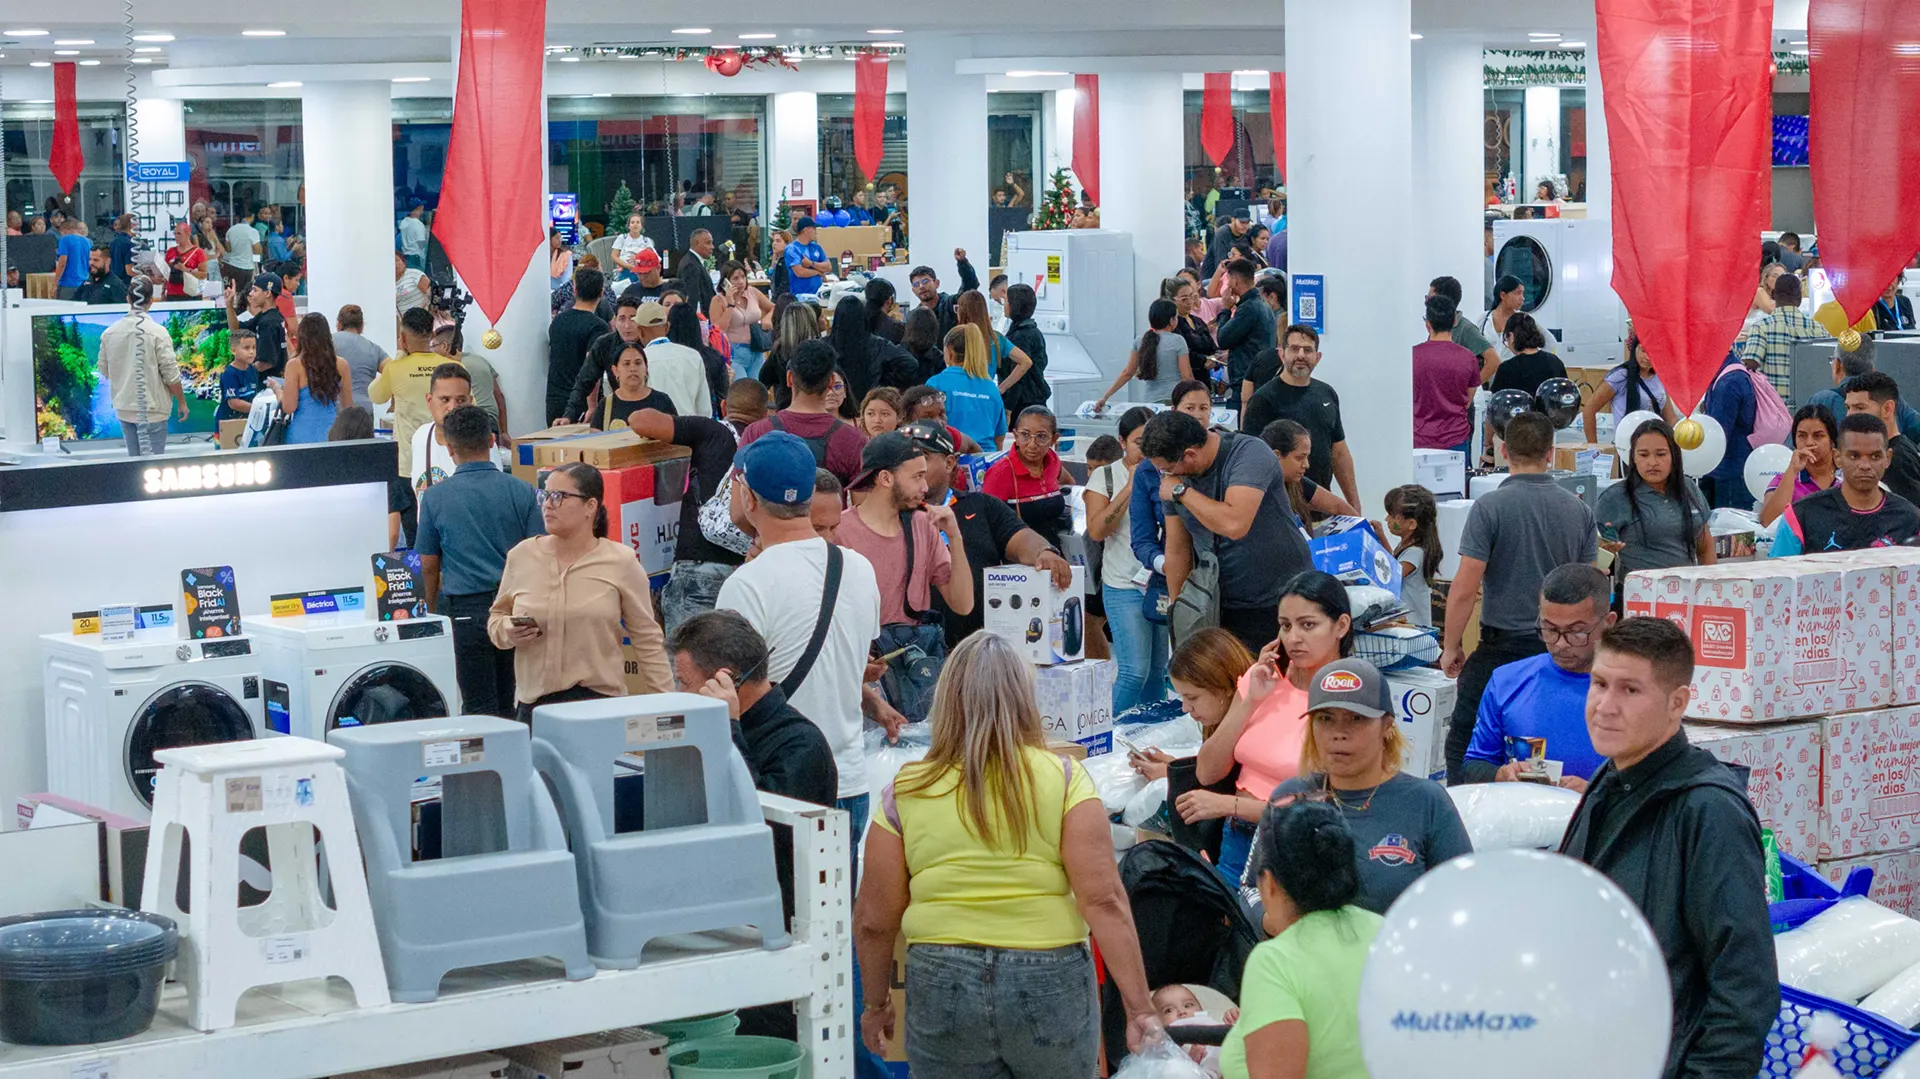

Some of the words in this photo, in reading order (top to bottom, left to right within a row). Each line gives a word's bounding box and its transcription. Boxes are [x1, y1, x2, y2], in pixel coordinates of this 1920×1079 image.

[141, 168, 176, 176] ROYAL
[143, 460, 272, 493] SAMSUNG
[630, 522, 641, 558] VC
[387, 571, 412, 582] Black
[988, 574, 1027, 582] DAEWOO
[388, 580, 414, 591] FridAI
[197, 588, 224, 598] Black
[199, 598, 226, 608] FridAI
[306, 600, 334, 609] Eléctrica
[1811, 604, 1820, 616] tu
[1822, 602, 1841, 620] mejo
[79, 619, 90, 628] 20
[1795, 636, 1808, 647] en
[1811, 632, 1827, 645] los
[1806, 620, 1840, 646] amigo
[1807, 646, 1830, 659] días
[244, 677, 257, 688] 20
[1078, 708, 1110, 732] OMEGA
[1890, 740, 1897, 752] tu
[1884, 754, 1919, 781] amigo
[1872, 772, 1885, 783] en
[1888, 768, 1903, 781] los
[1883, 781, 1905, 795] días
[1391, 1008, 1538, 1032] MultiMax
